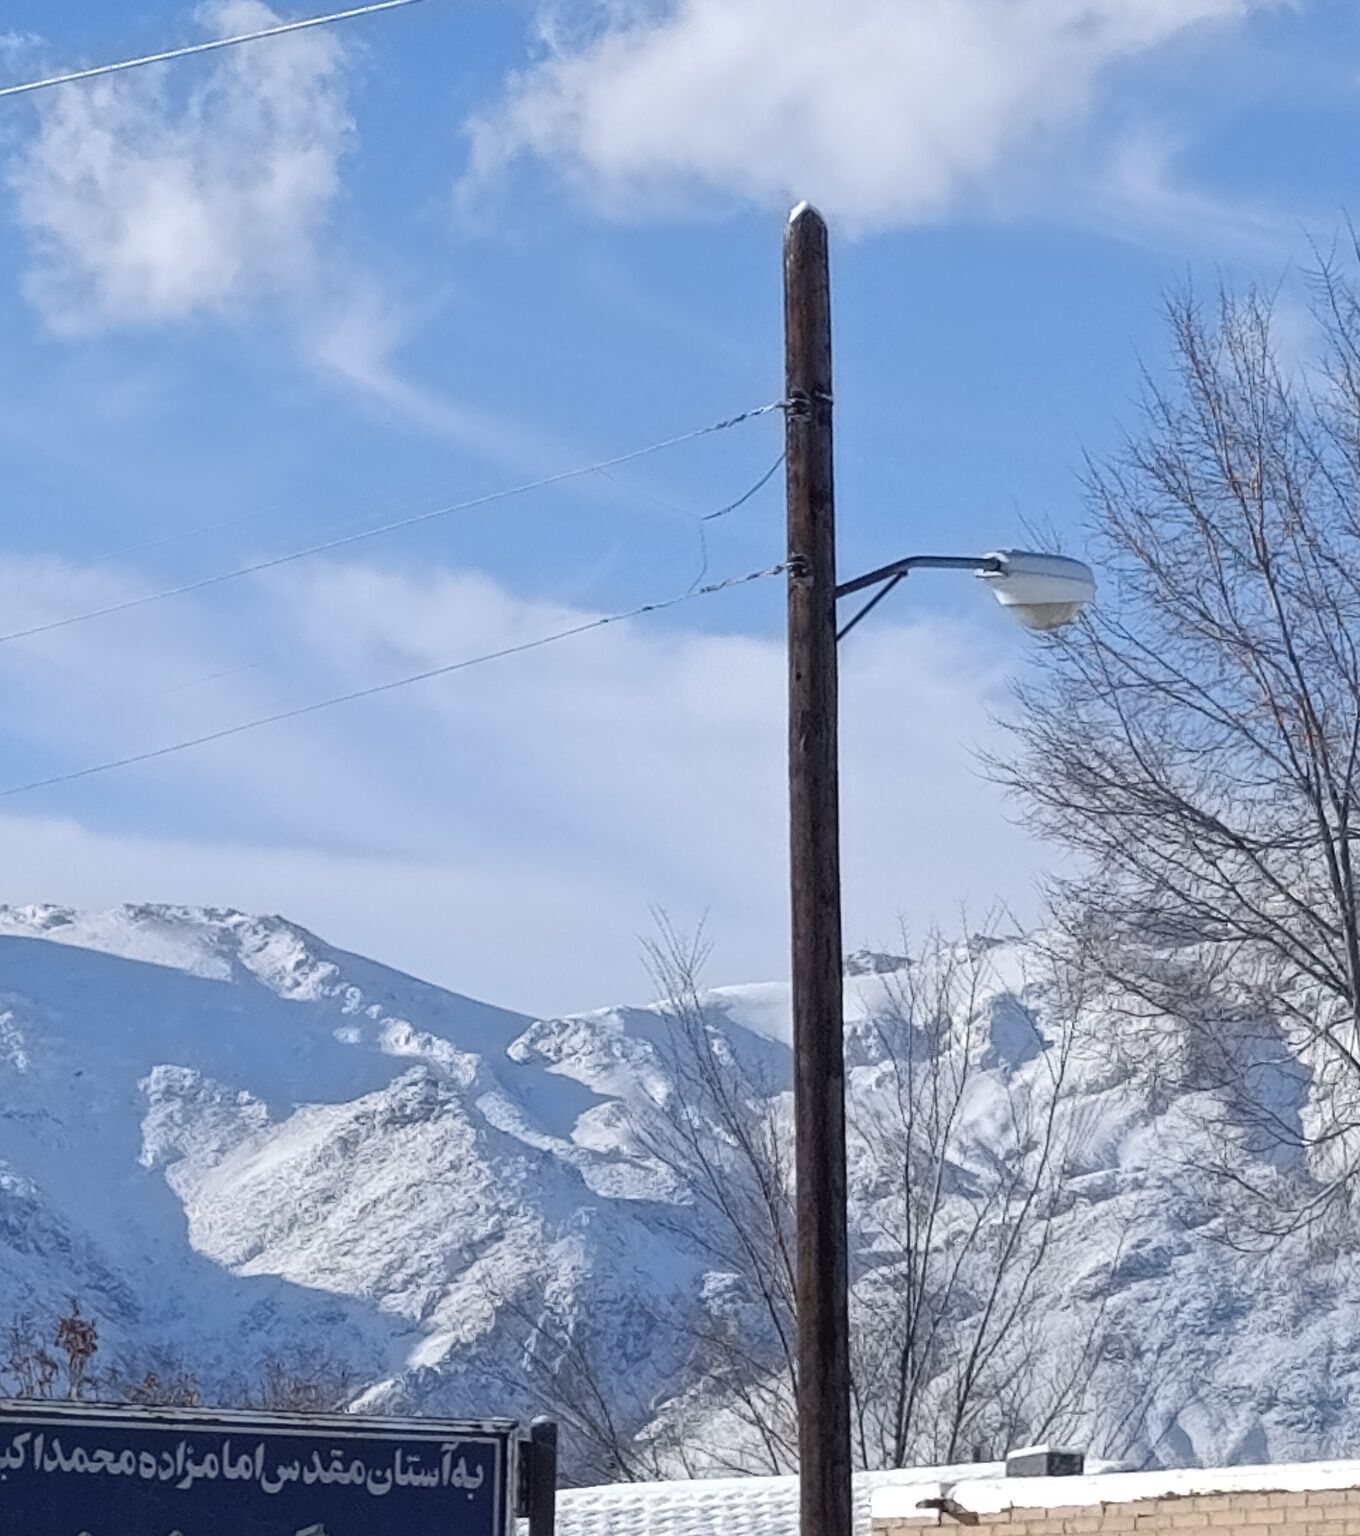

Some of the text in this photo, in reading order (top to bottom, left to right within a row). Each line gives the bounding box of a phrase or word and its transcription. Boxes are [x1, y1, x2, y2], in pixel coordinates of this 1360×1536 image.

[43, 1438, 136, 1476] محمد
[139, 1440, 266, 1489] امامزاده
[261, 1449, 366, 1494] مقدس
[366, 1441, 460, 1496] آستان
[450, 1456, 485, 1500] به
